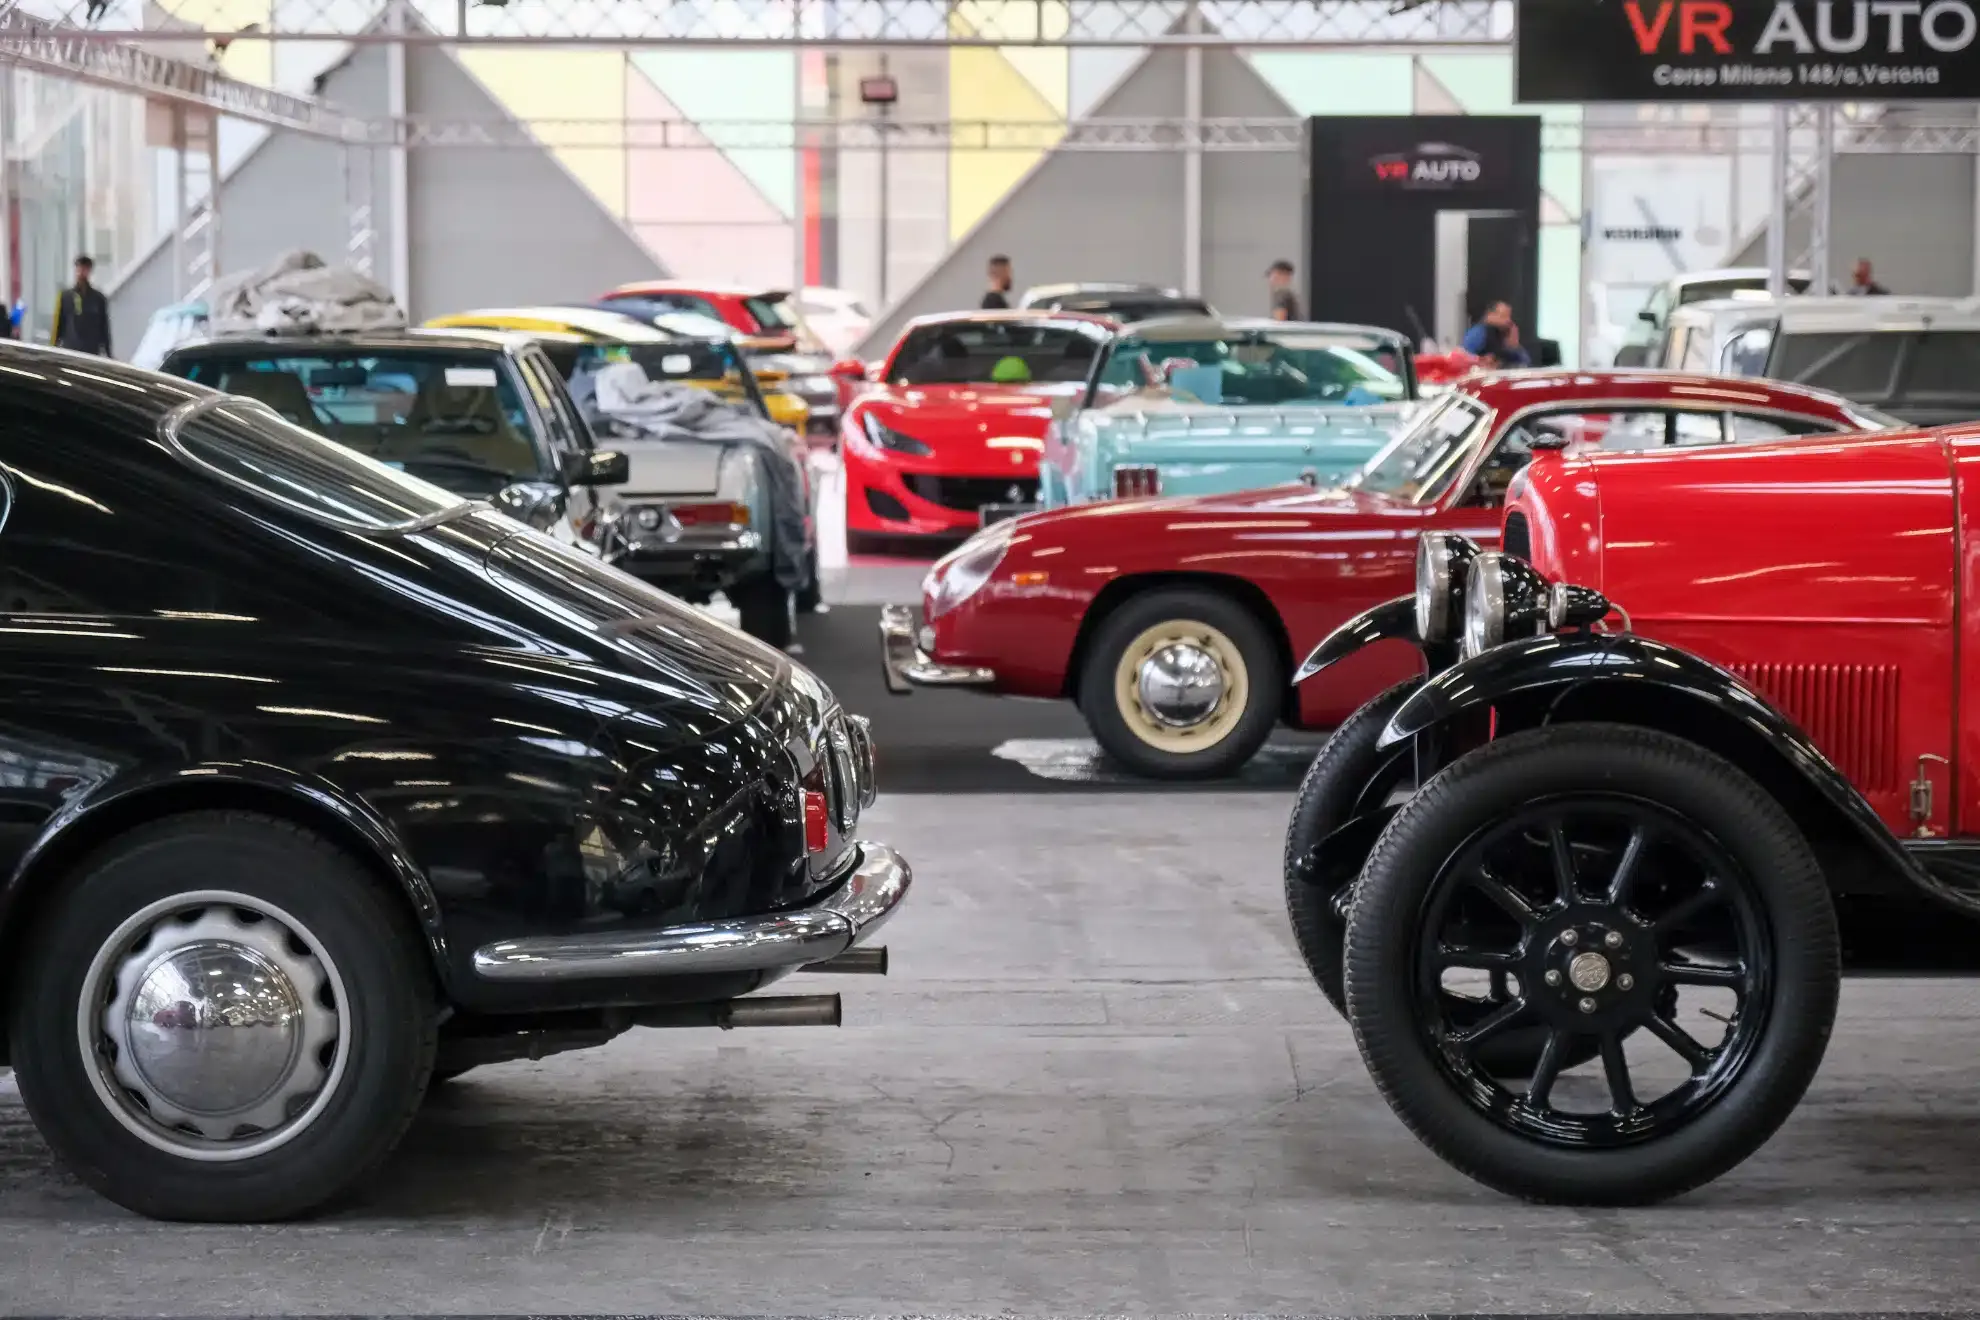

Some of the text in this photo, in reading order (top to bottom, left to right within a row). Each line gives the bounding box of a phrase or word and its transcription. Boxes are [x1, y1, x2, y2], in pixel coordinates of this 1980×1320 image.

[1622, 0, 1977, 54] VR AUTO
[1653, 64, 1717, 86] Corso
[1719, 63, 1793, 85] Milano
[1375, 159, 1480, 181] VR AUTO
